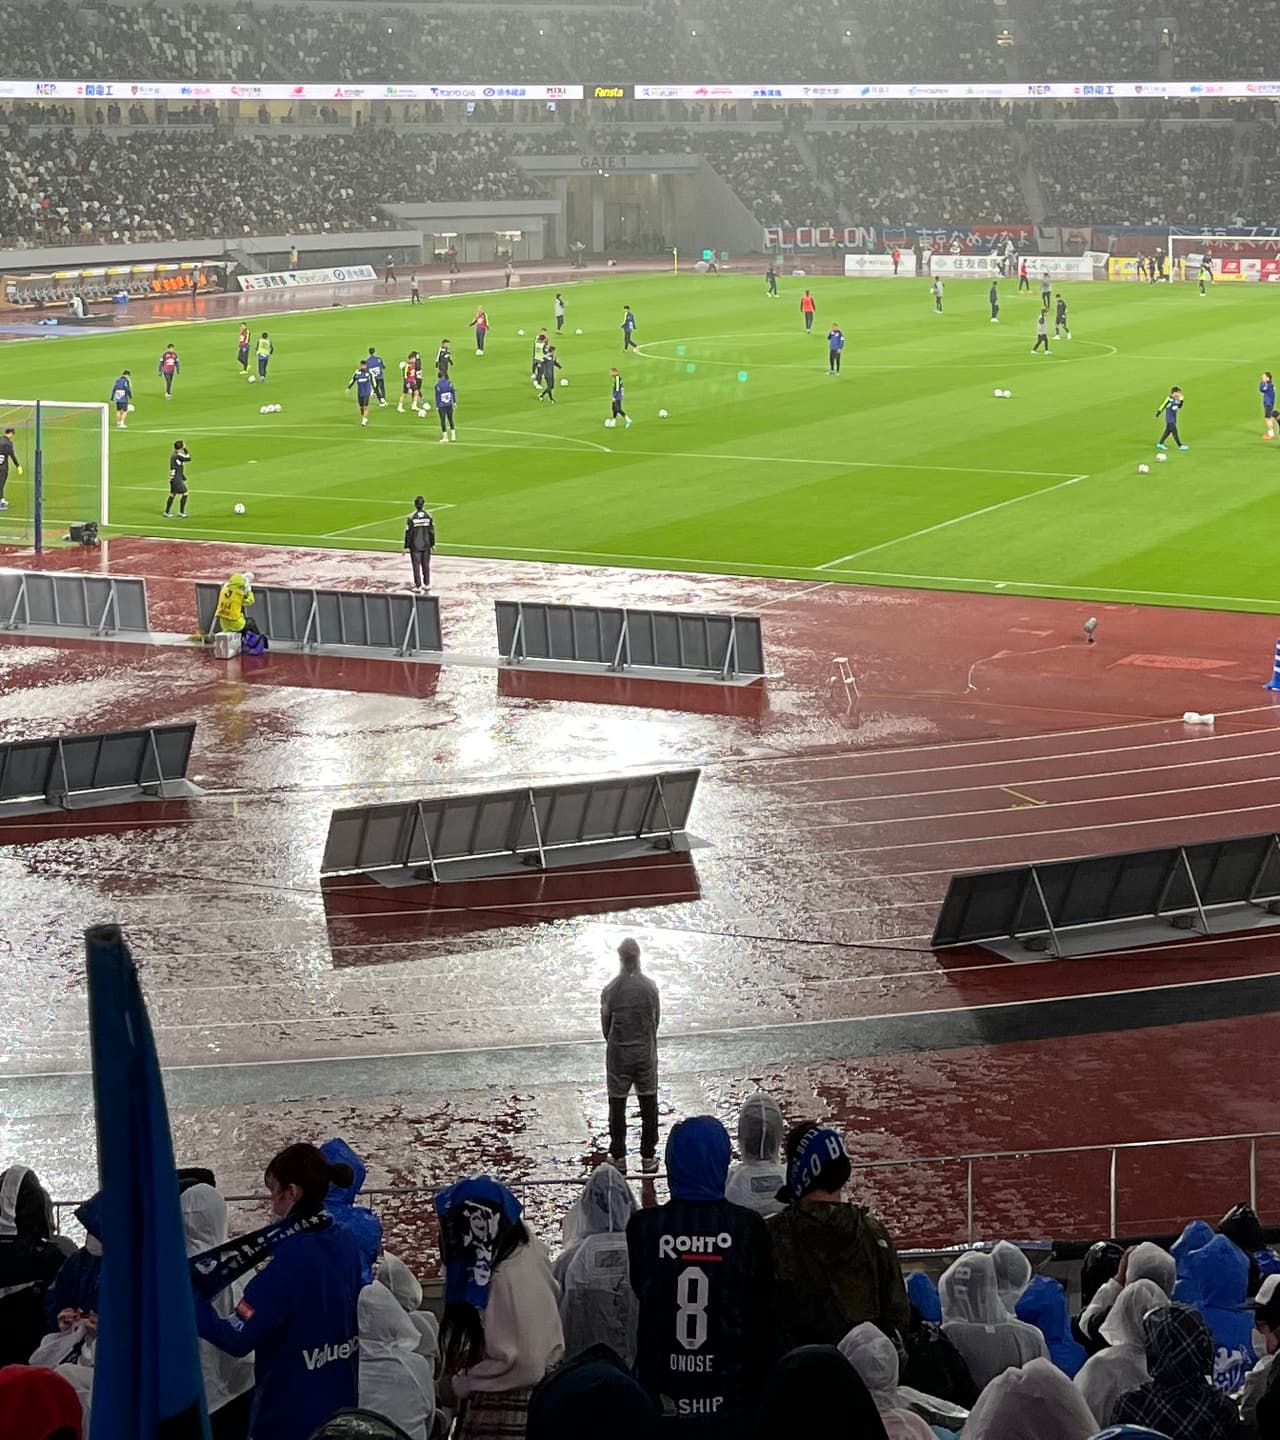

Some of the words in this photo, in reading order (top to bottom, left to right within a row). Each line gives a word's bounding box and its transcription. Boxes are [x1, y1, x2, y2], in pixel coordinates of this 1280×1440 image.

[581, 157, 615, 169] GATE
[621, 157, 628, 168] 1
[658, 1232, 732, 1260] ROHTO
[676, 1266, 709, 1350] 8
[670, 1353, 715, 1372] ONOSE
[679, 1396, 724, 1415] SHIP
